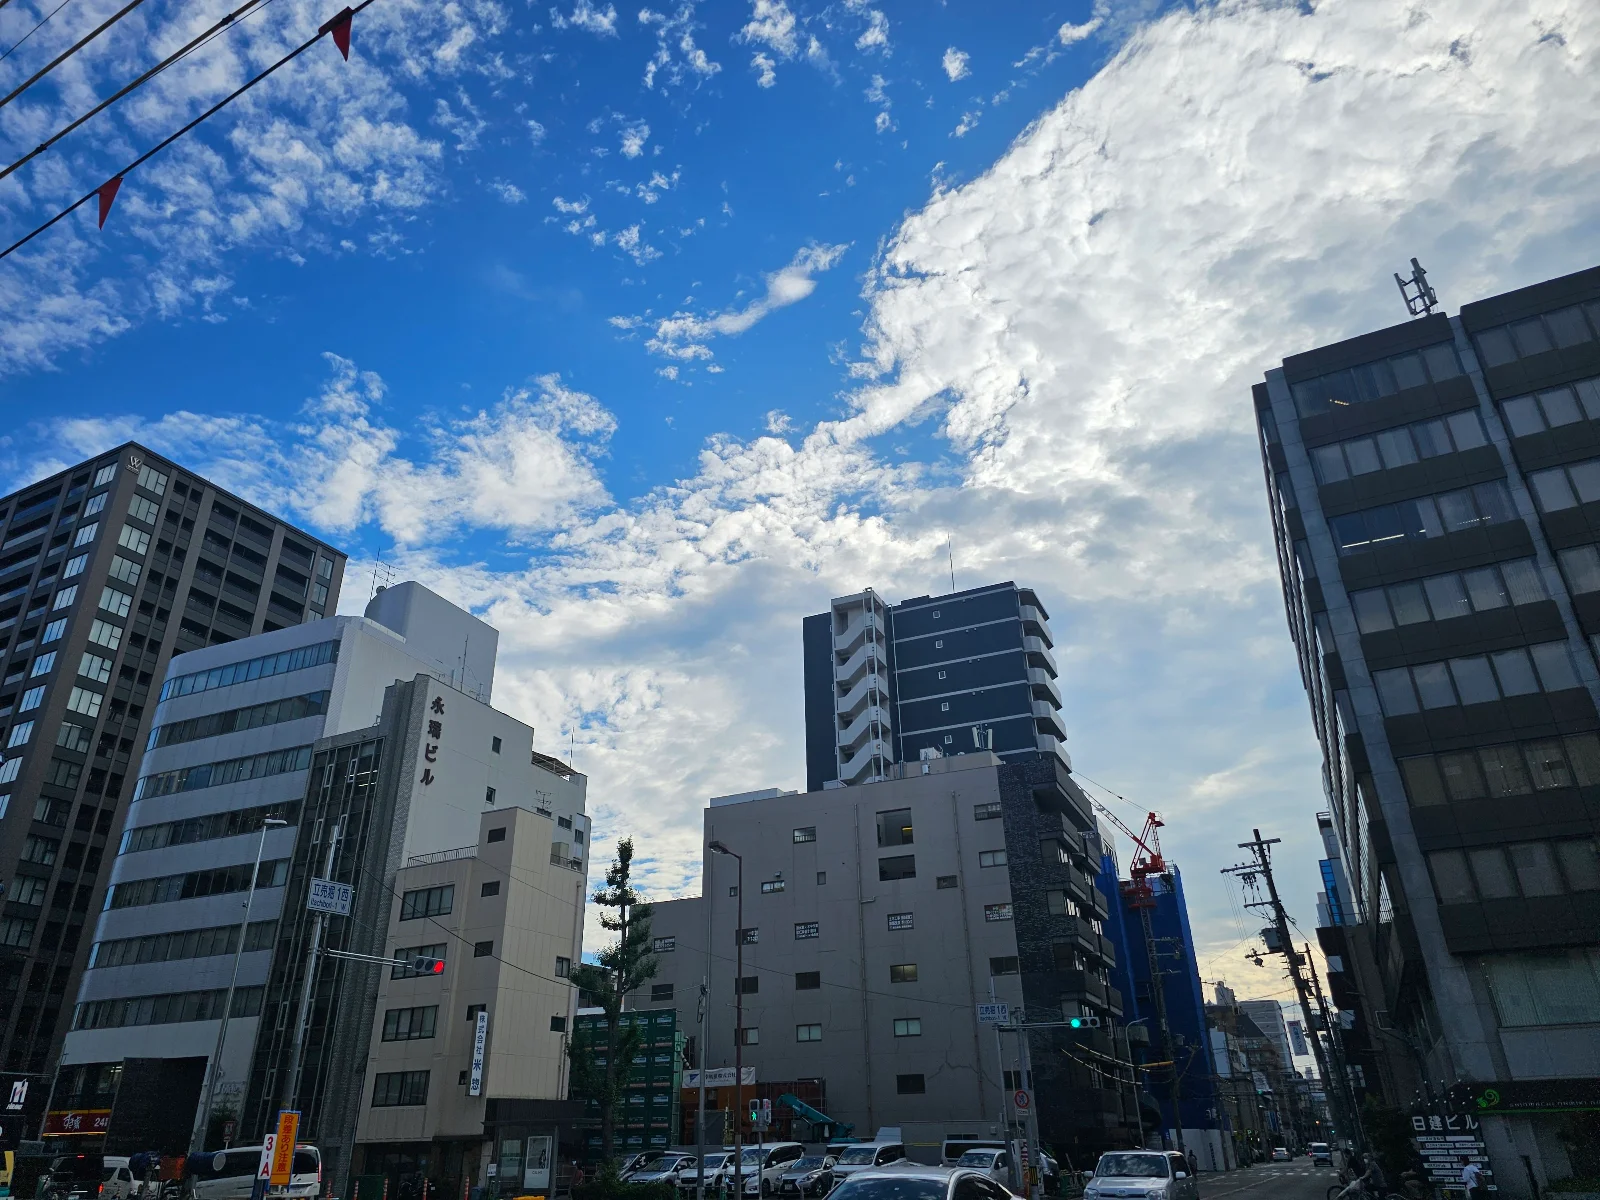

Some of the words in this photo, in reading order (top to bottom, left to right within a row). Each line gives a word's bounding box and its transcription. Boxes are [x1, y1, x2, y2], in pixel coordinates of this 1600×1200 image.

[420, 696, 445, 786] 永瑞ビル
[276, 1114, 294, 1172] 段差あり注意
[1412, 1114, 1479, 1131] 日建ビル
